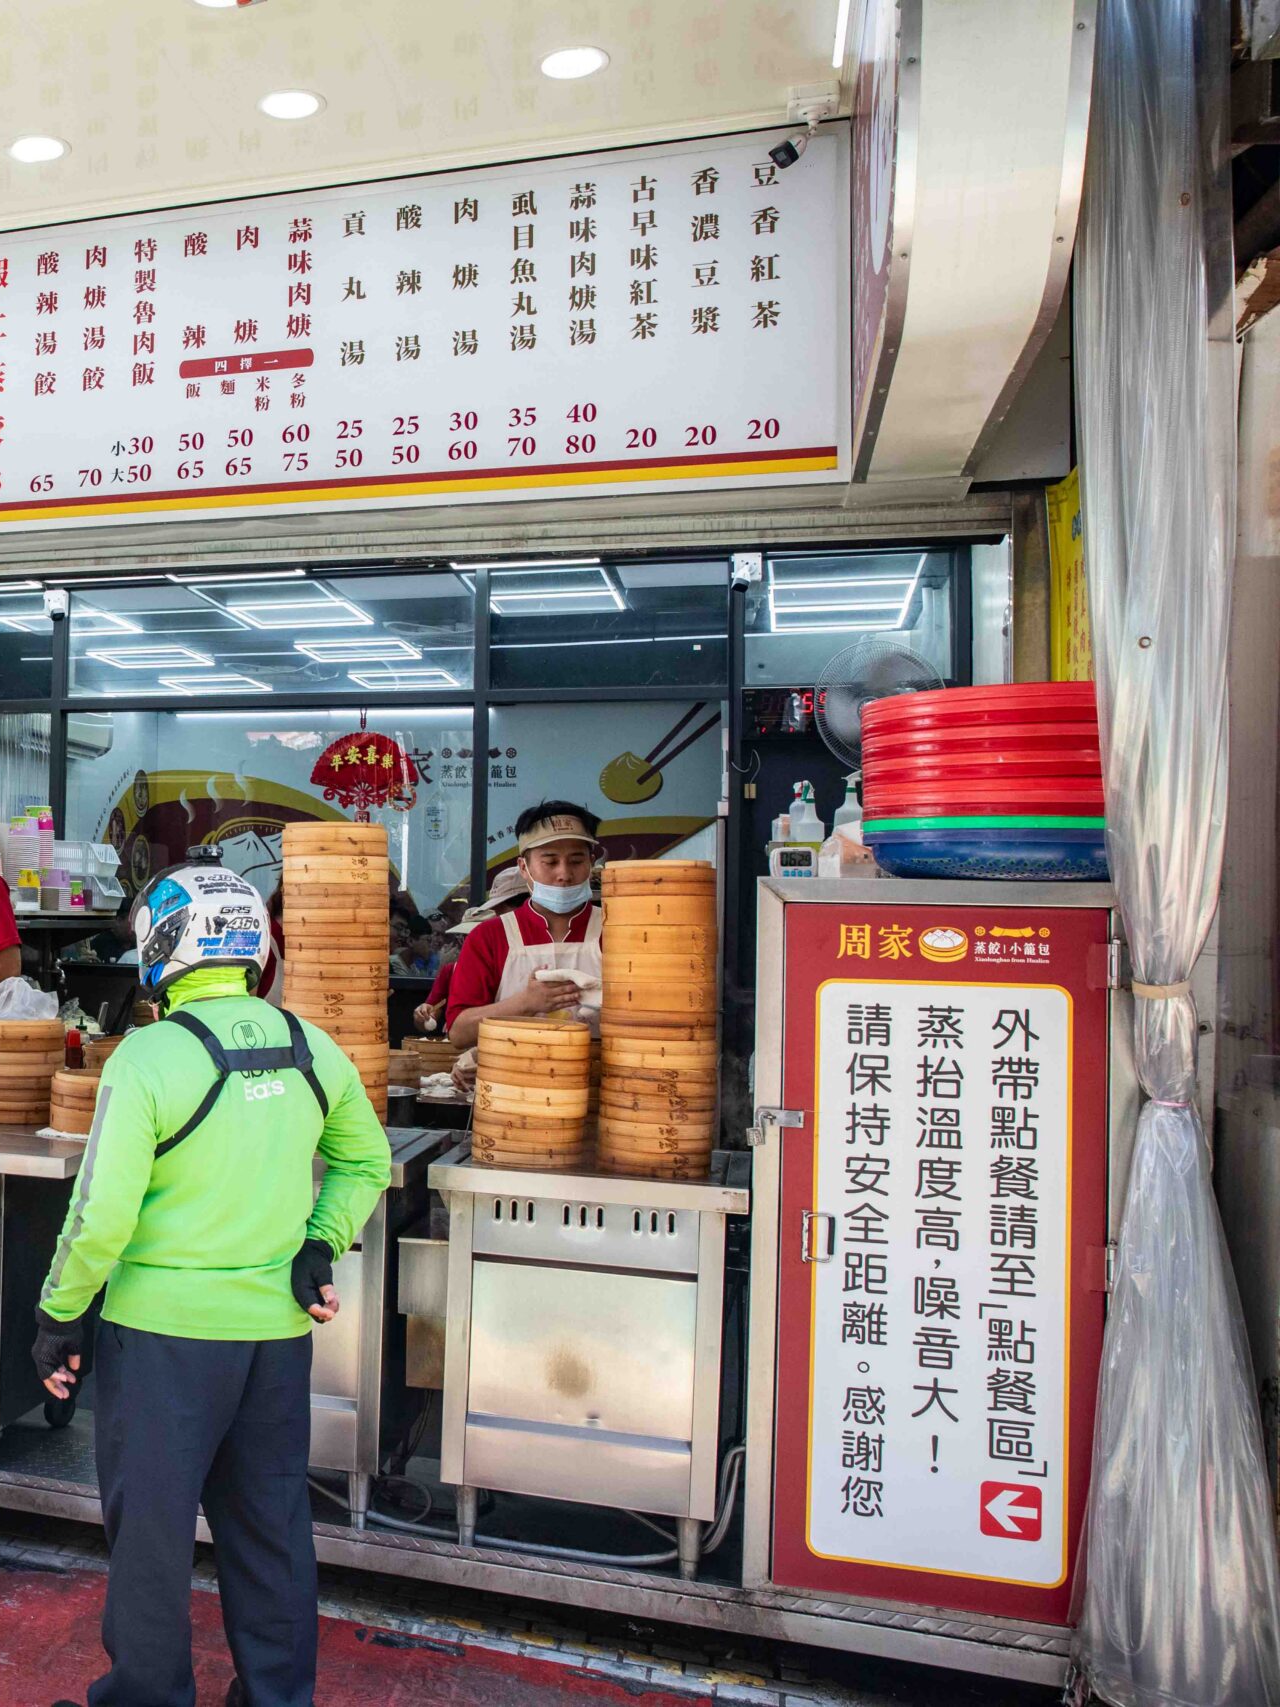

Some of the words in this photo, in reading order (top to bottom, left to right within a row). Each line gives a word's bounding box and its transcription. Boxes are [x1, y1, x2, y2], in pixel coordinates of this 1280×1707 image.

[630, 176, 658, 339] 古早味紅茶
[691, 167, 720, 334] 香濃豆漿
[750, 162, 781, 329] 豆香紅茶
[183, 232, 208, 349] 酸辣
[340, 211, 366, 366] 貢丸湯
[396, 204, 422, 361] 酸辣湯
[35, 251, 59, 396] 酸辣湯餃
[132, 238, 157, 386] 特製魯肉飯
[214, 356, 279, 374] 四擇一
[186, 383, 200, 399] 飯
[254, 376, 270, 411] 米粉
[290, 373, 306, 409] 冬粉
[179, 432, 204, 451] 50
[227, 429, 253, 447] 50
[282, 424, 310, 443] 60
[337, 420, 362, 439] 25
[393, 416, 419, 435] 25
[449, 412, 478, 431] 30
[509, 407, 536, 427] 35
[567, 403, 597, 423] 40
[626, 428, 657, 448] 20
[685, 426, 717, 446] 20
[747, 419, 780, 439] 20
[177, 461, 203, 479] 65
[226, 457, 251, 476] 65
[283, 453, 308, 471] 75
[335, 449, 362, 468] 50
[392, 445, 419, 464] 50
[448, 441, 477, 460] 60
[508, 437, 536, 456] 70
[566, 434, 596, 454] 80
[30, 475, 53, 492] 65
[79, 469, 102, 487] 70
[220, 906, 252, 914] GRS
[226, 916, 254, 930] 46
[837, 923, 914, 960] 周家
[974, 956, 1011, 964] Xiaolongbao
[979, 1009, 1048, 1482] 外帶點餐請至「點餐區」
